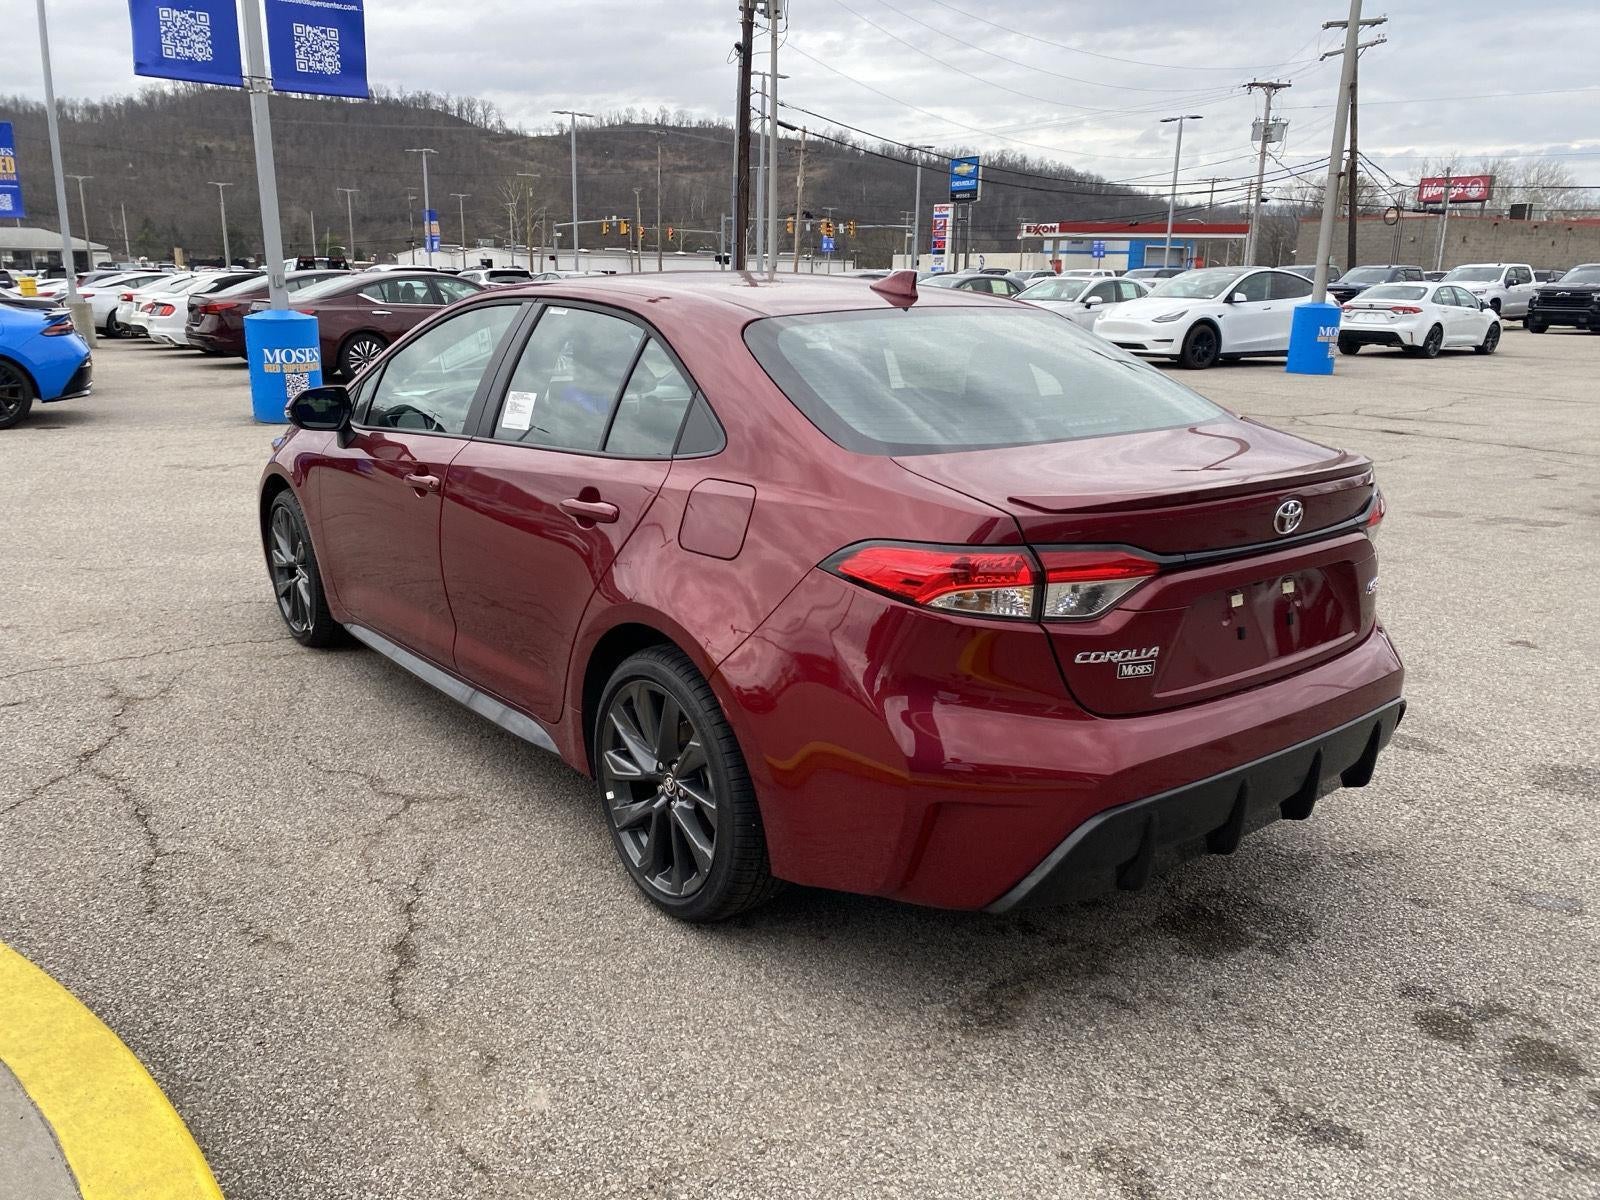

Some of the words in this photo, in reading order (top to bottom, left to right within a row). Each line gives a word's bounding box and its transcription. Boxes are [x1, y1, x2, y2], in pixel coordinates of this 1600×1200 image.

[1026, 224, 1057, 236] EXXON
[262, 346, 320, 364] MOSES
[1074, 646, 1160, 664] COROLLA
